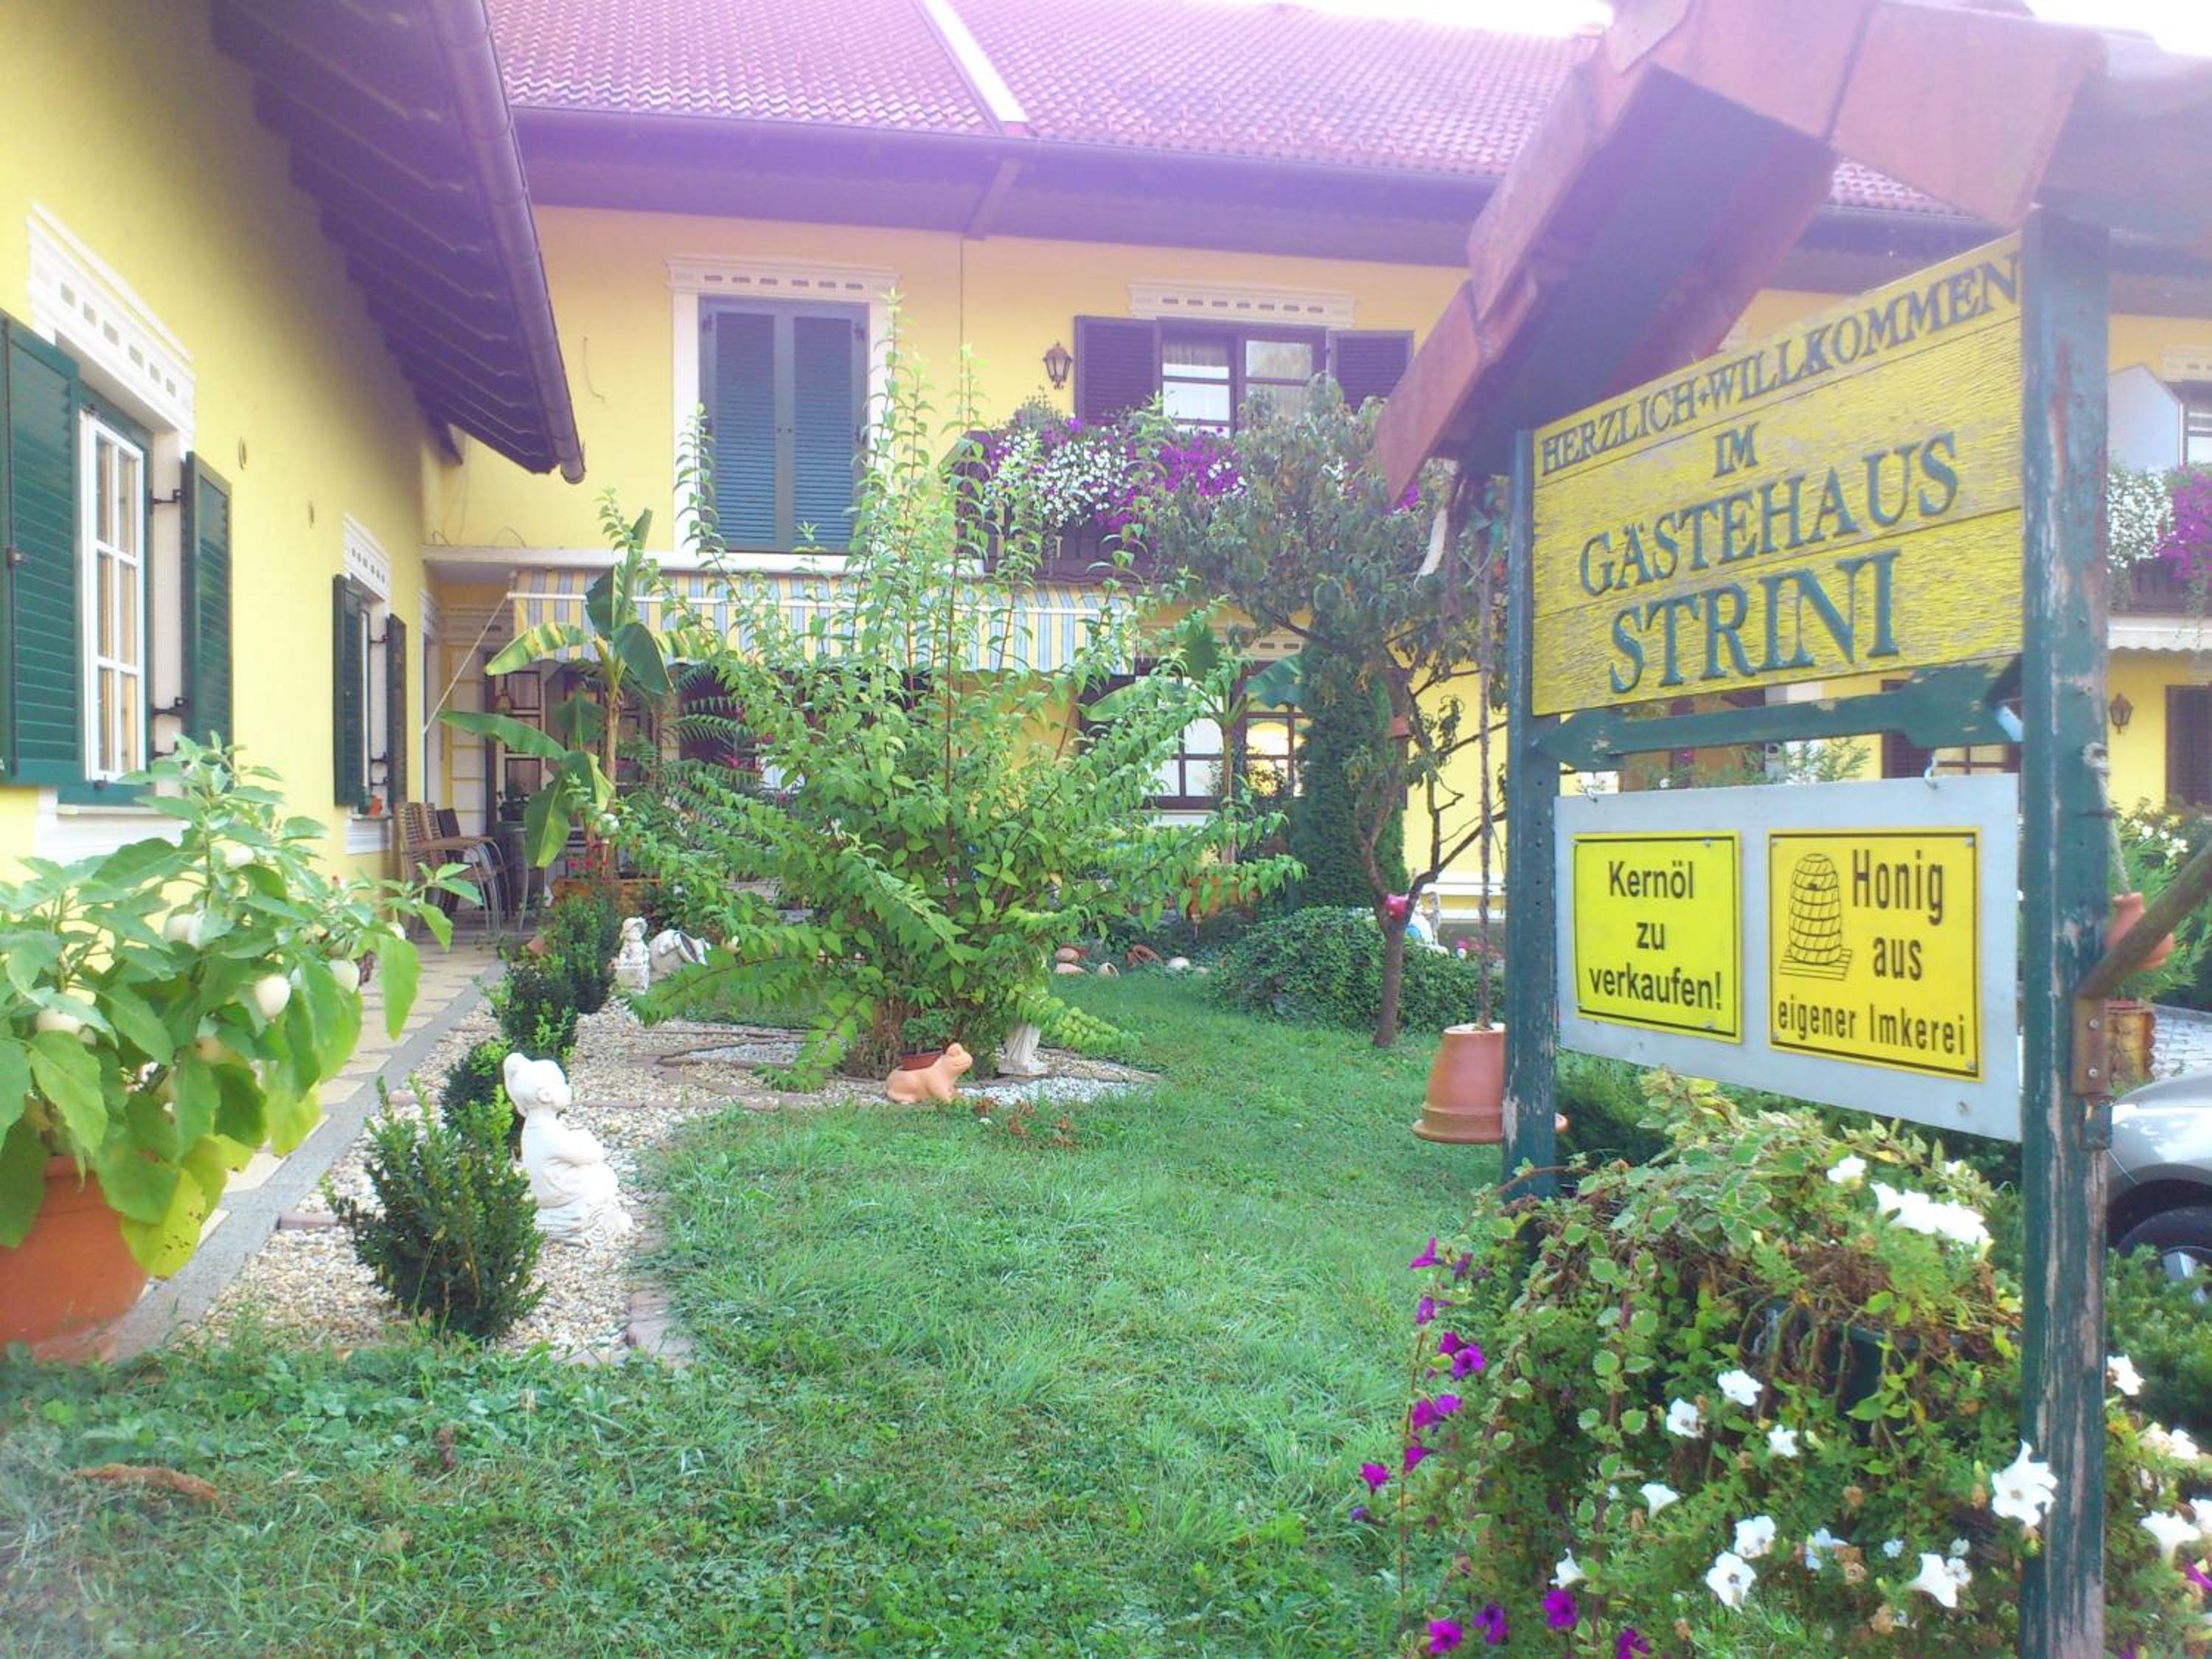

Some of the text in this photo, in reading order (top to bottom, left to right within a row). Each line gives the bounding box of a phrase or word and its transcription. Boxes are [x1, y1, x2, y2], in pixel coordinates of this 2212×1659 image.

[1714, 422, 1760, 478] IM
[1579, 431, 1958, 596] GÄSTEHAUS
[1609, 549, 1901, 694] STRINI
[1609, 860, 1694, 899] Kernöl
[1851, 849, 1944, 926] Honig
[1635, 921, 1666, 951] zu
[1872, 935, 1922, 981] aus
[1588, 964, 1722, 1010] verkaufen!
[1778, 998, 1966, 1055] eigener Imkerei
